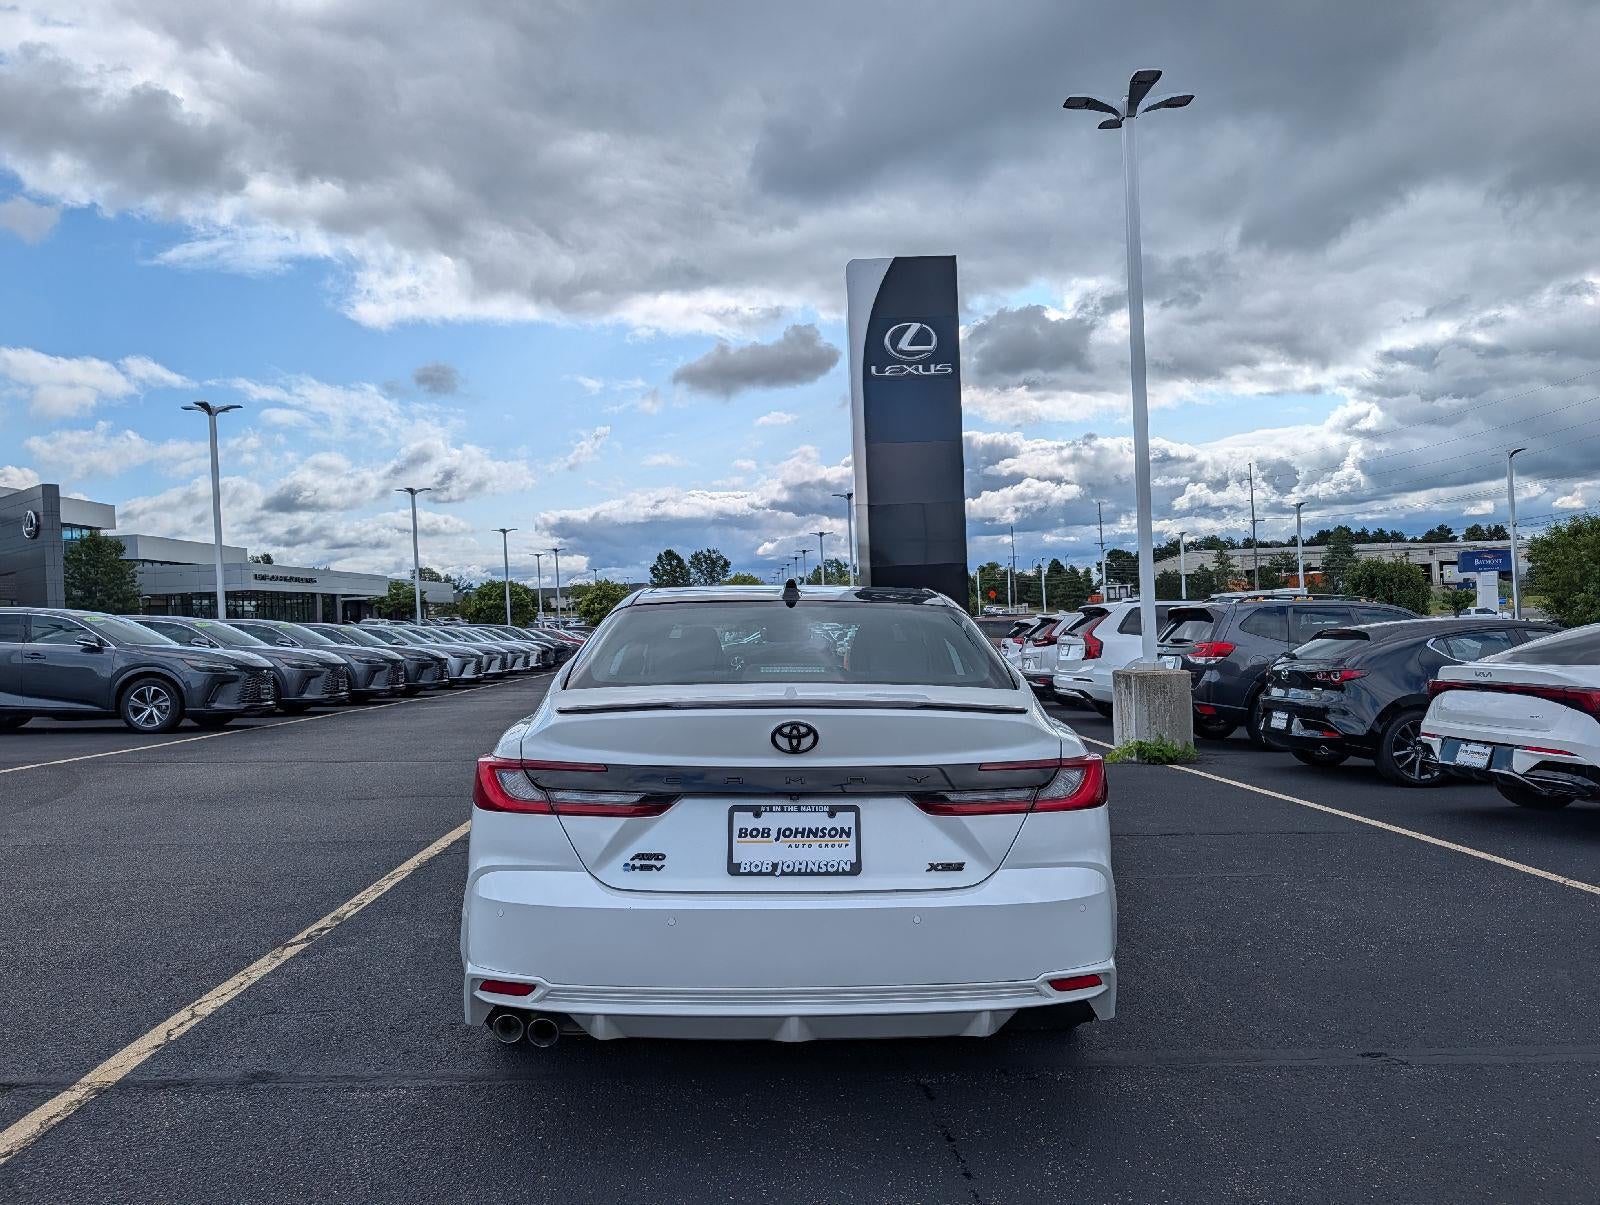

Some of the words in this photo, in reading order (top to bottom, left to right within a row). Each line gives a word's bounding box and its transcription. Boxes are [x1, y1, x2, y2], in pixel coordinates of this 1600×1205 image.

[870, 363, 954, 377] LEXUS
[737, 827, 772, 839] BOB
[774, 826, 852, 842] JOHNSON
[629, 852, 667, 861] AWD
[740, 860, 773, 873] BOB
[774, 860, 851, 877] JOHNSON
[925, 861, 966, 872] XSE
